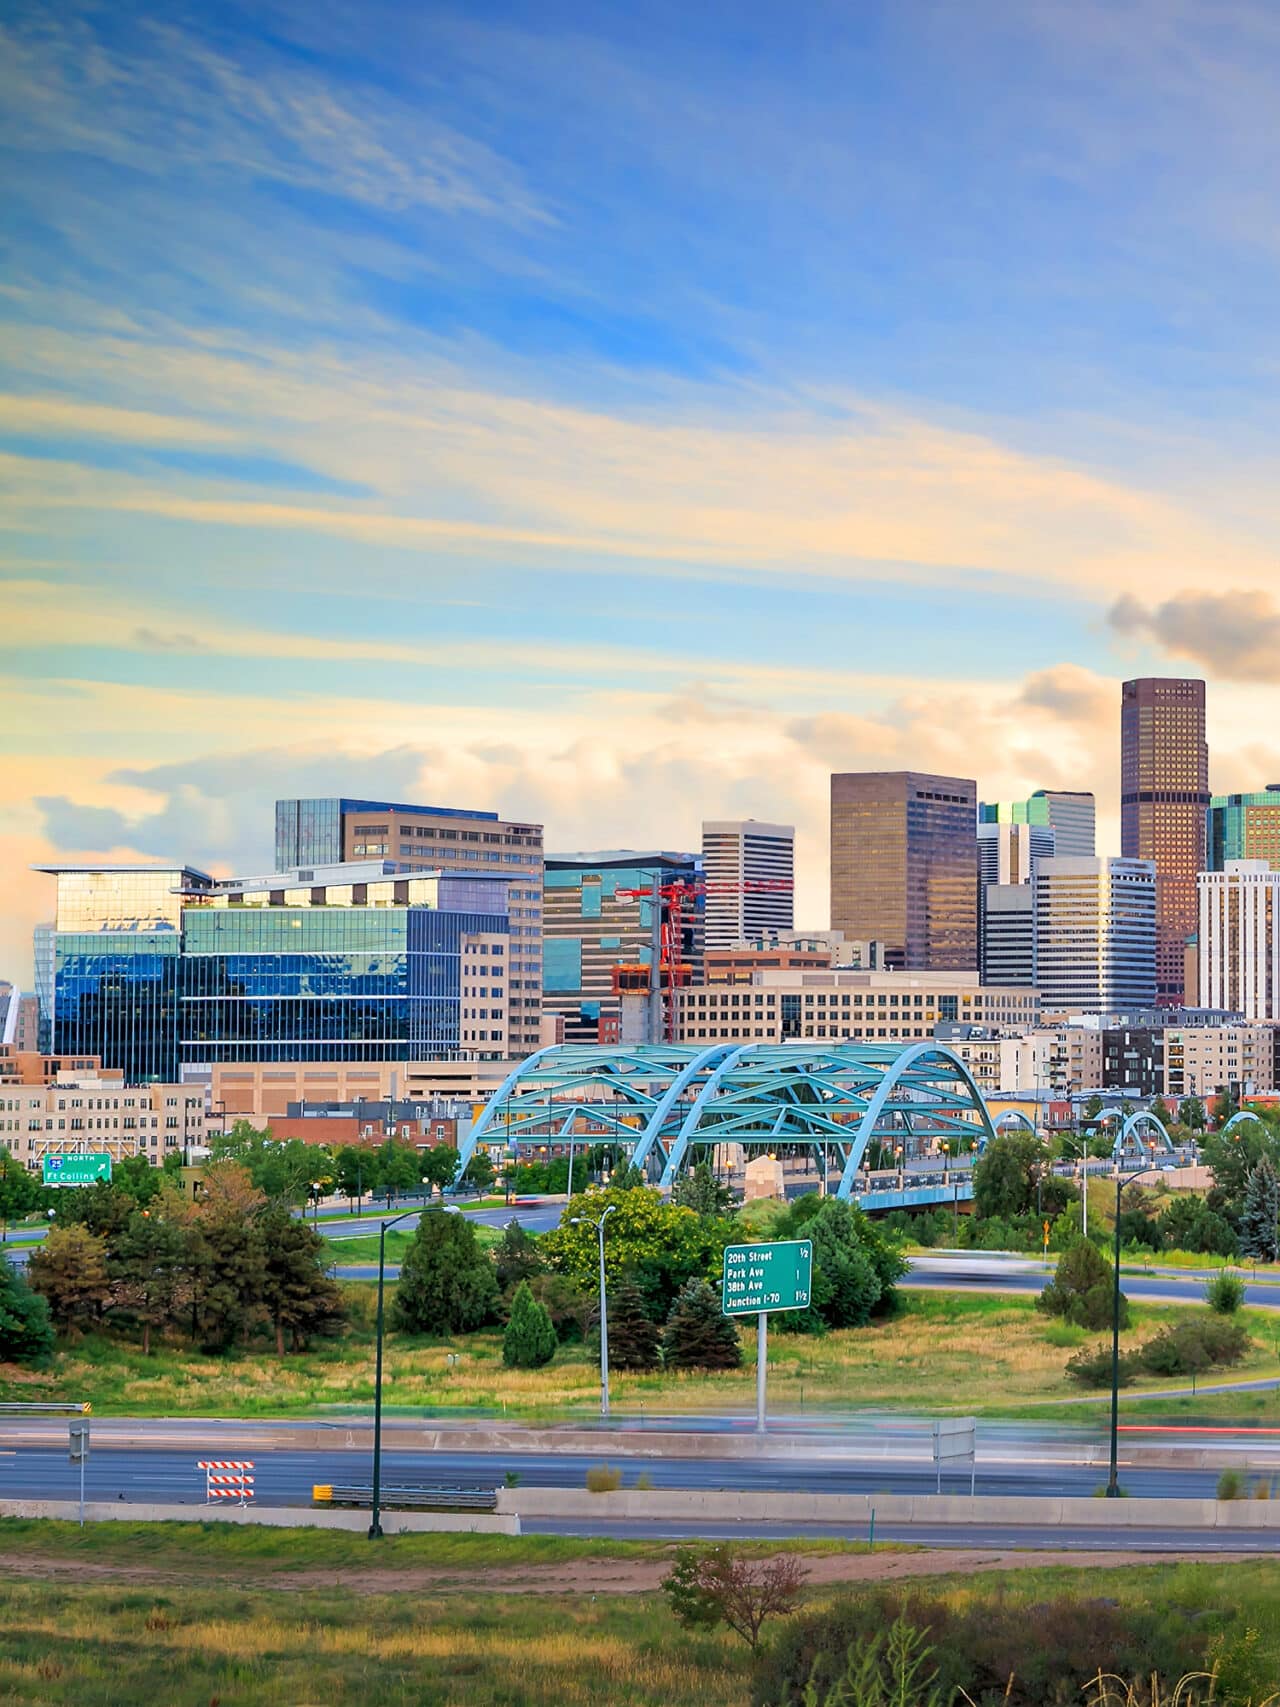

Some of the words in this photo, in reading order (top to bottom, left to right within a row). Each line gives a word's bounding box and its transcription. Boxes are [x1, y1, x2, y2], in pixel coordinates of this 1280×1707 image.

[51, 1160, 62, 1168] 25
[47, 1172, 58, 1180] Ft
[60, 1172, 95, 1180] Collins
[728, 1253, 746, 1264] 20th
[749, 1251, 772, 1262] Street
[727, 1268, 746, 1279] Park
[749, 1267, 764, 1278] Ave
[727, 1282, 745, 1292] 38th
[748, 1280, 763, 1291] Ave
[727, 1296, 761, 1307] Junction
[763, 1293, 780, 1304] I-70
